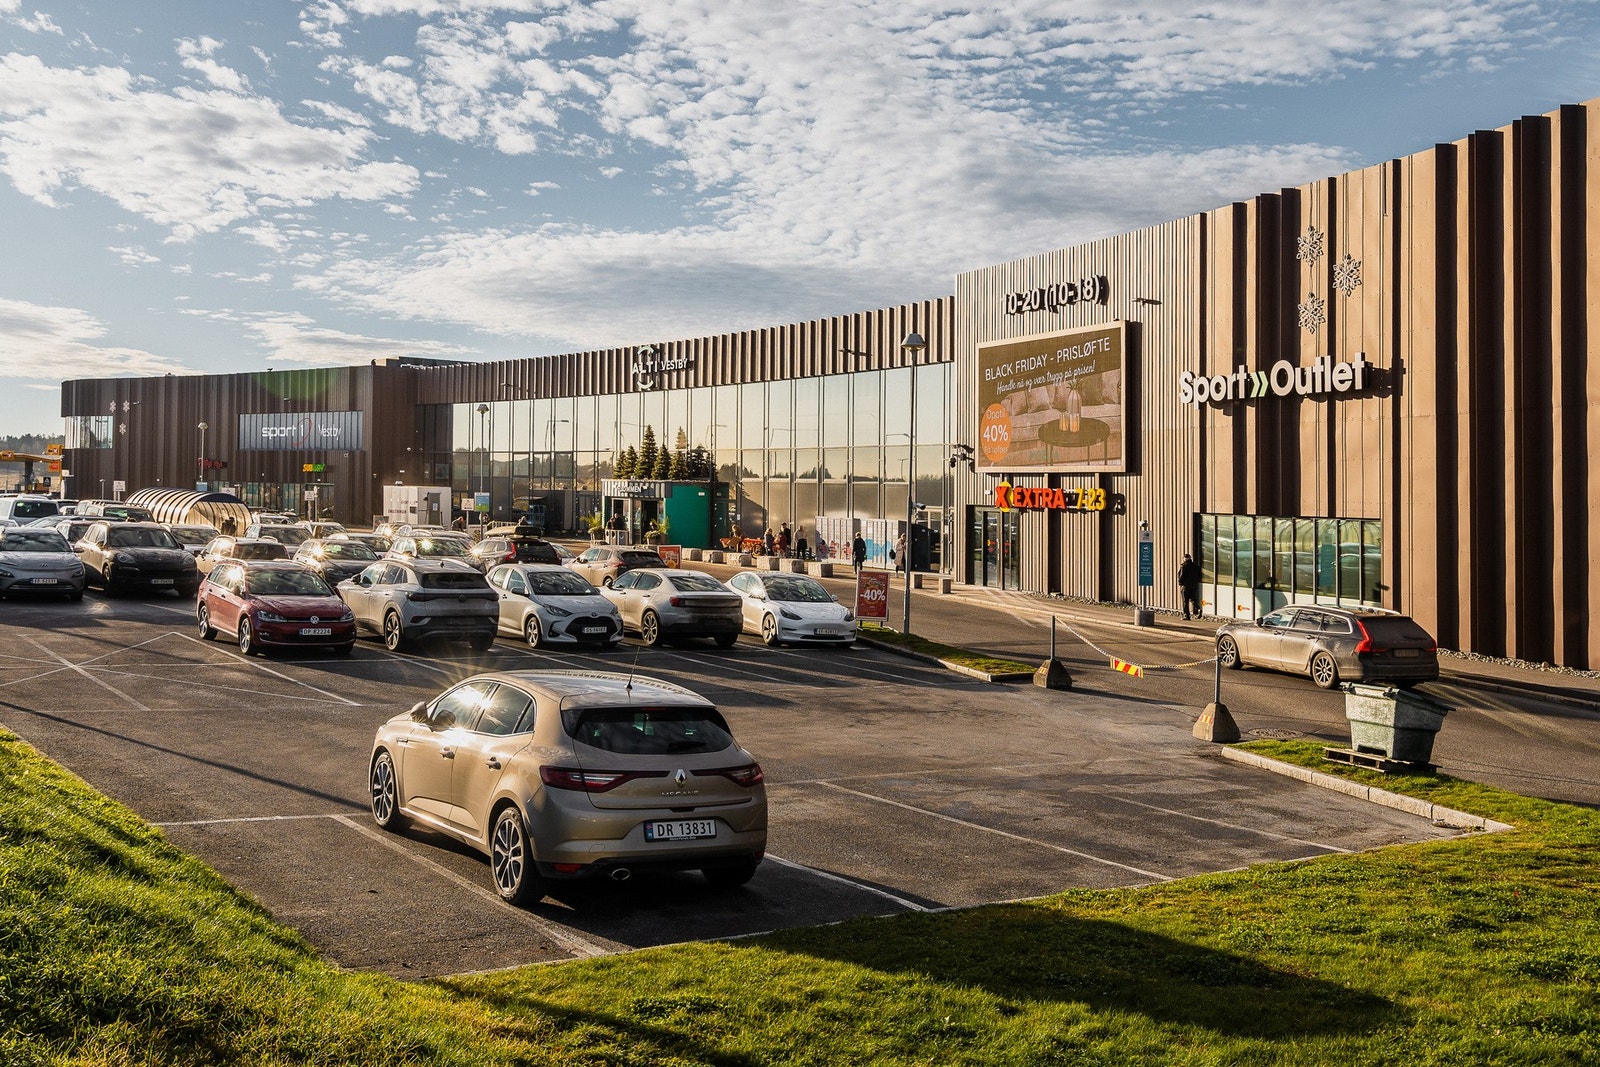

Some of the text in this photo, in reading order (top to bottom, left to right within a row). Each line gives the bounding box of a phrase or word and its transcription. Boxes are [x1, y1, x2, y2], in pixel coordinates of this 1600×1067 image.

[633, 358, 688, 374] ALTI VESTBY
[985, 362, 1013, 381] BLACK
[1015, 354, 1048, 374] FRIDAY
[1057, 337, 1111, 363] PRISLØFTE
[1179, 352, 1365, 410] Sport Outlet
[262, 425, 297, 440] sport
[318, 424, 342, 440] Vestby
[983, 424, 1009, 442] 40%
[1013, 487, 1066, 509] EXTRA
[1075, 488, 1106, 511] 7-23
[860, 589, 885, 601] -40%
[657, 822, 712, 837] DR 13831
